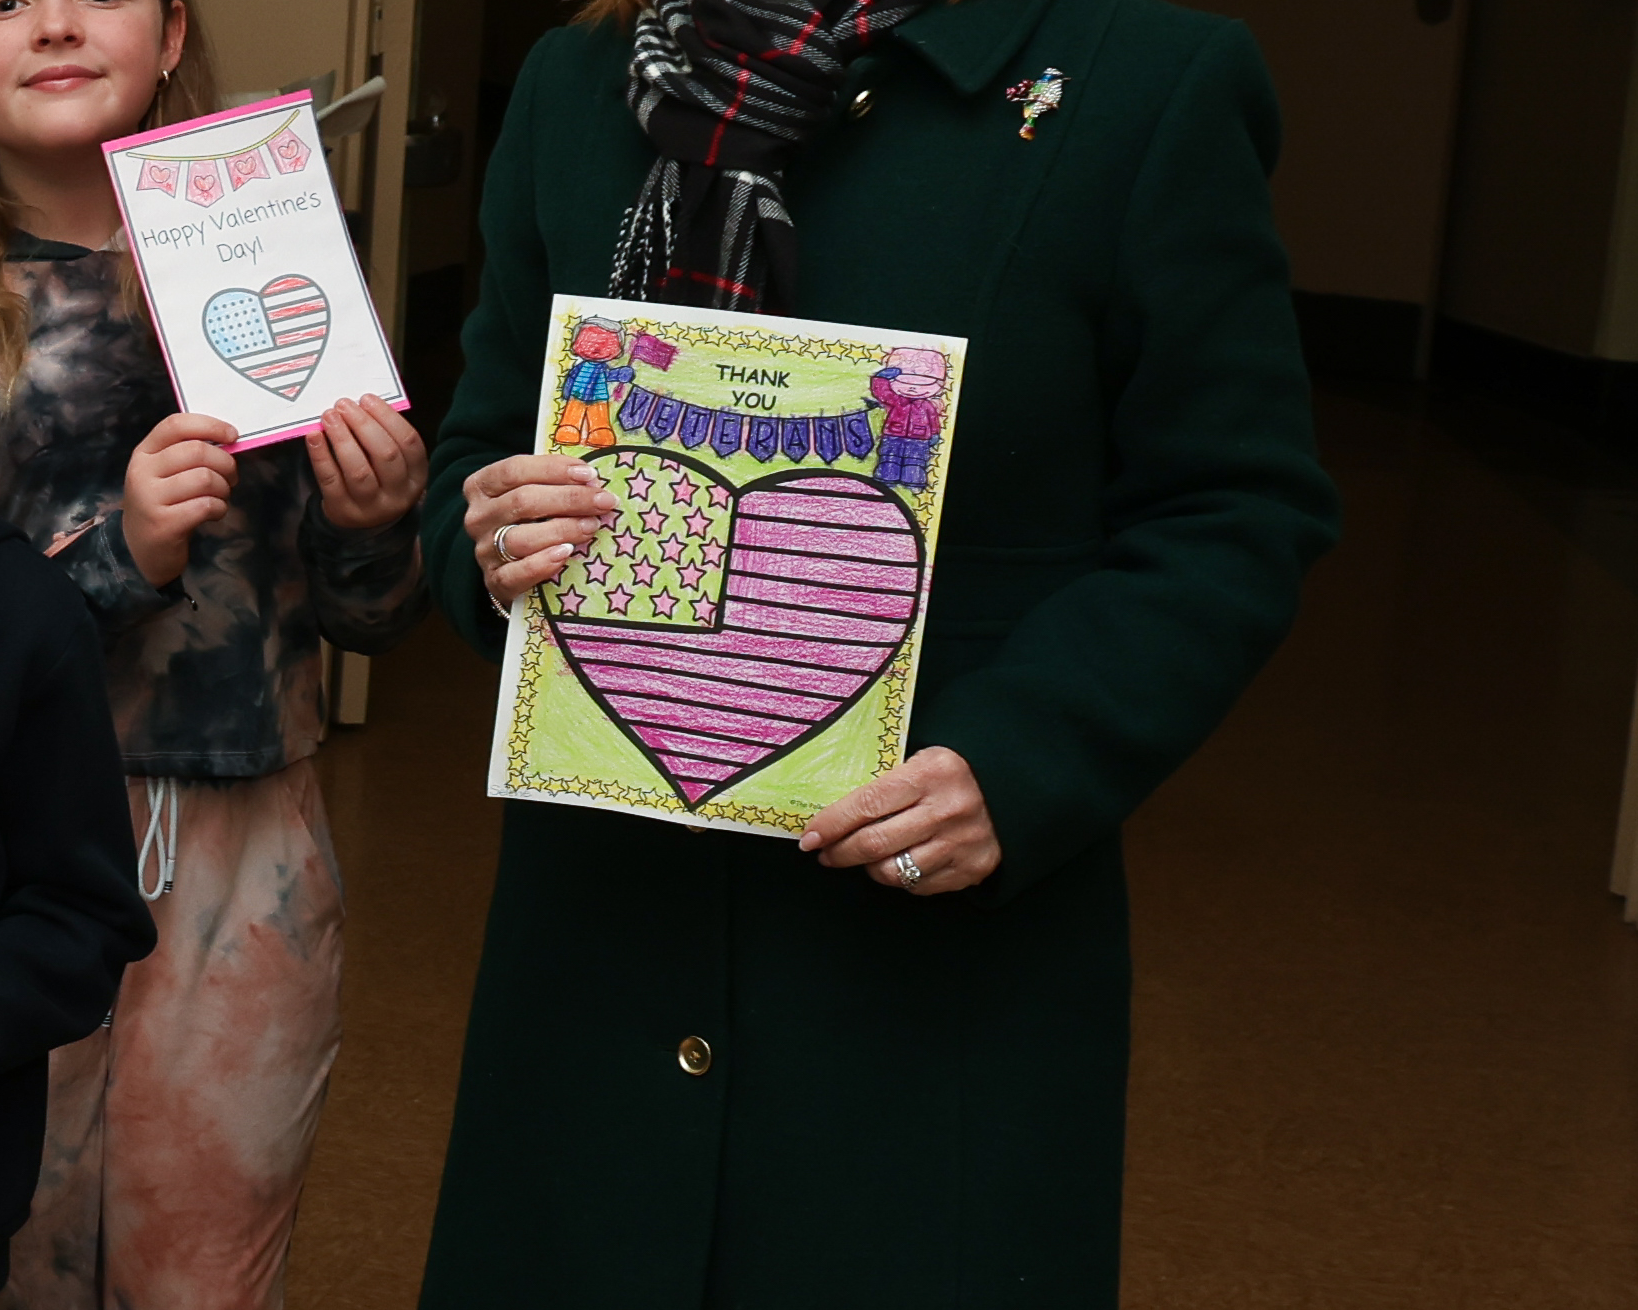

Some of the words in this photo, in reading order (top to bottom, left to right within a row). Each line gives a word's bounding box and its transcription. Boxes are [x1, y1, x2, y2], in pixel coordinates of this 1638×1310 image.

[140, 221, 206, 250] Happy
[209, 191, 322, 232] Valentine's
[216, 236, 265, 266] Day!
[715, 363, 791, 390] THANK
[731, 390, 778, 411] YOU
[625, 394, 865, 451] VETERANS
